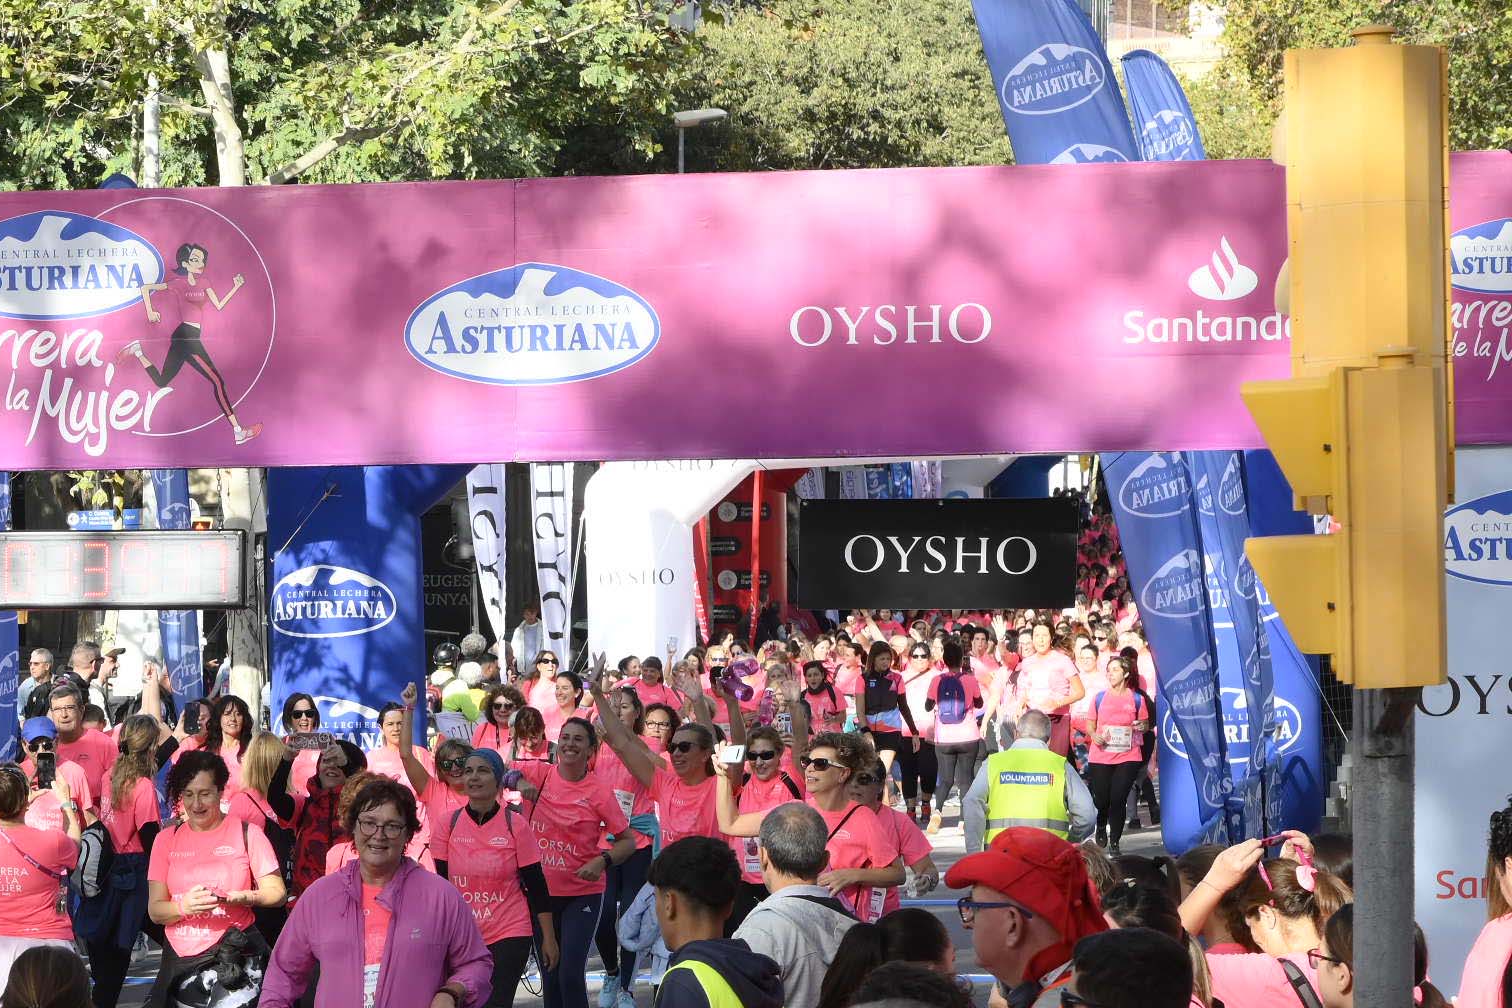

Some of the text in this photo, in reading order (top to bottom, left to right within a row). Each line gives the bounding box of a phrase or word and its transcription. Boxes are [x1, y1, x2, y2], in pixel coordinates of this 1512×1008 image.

[67, 248, 138, 259] LECHERA
[464, 303, 632, 320] CENTRAL LECHERA
[425, 310, 640, 356] ASTURIANA
[789, 303, 992, 347] OYSHO
[5, 372, 30, 412] la
[26, 361, 174, 456] Mujer
[844, 534, 1038, 575] OYSHO
[287, 589, 382, 599] CENTRAL LECHERA
[274, 594, 387, 623] ASTURIANA
[1000, 773, 1049, 784] VOLUNTARIS
[453, 876, 467, 888] TU
